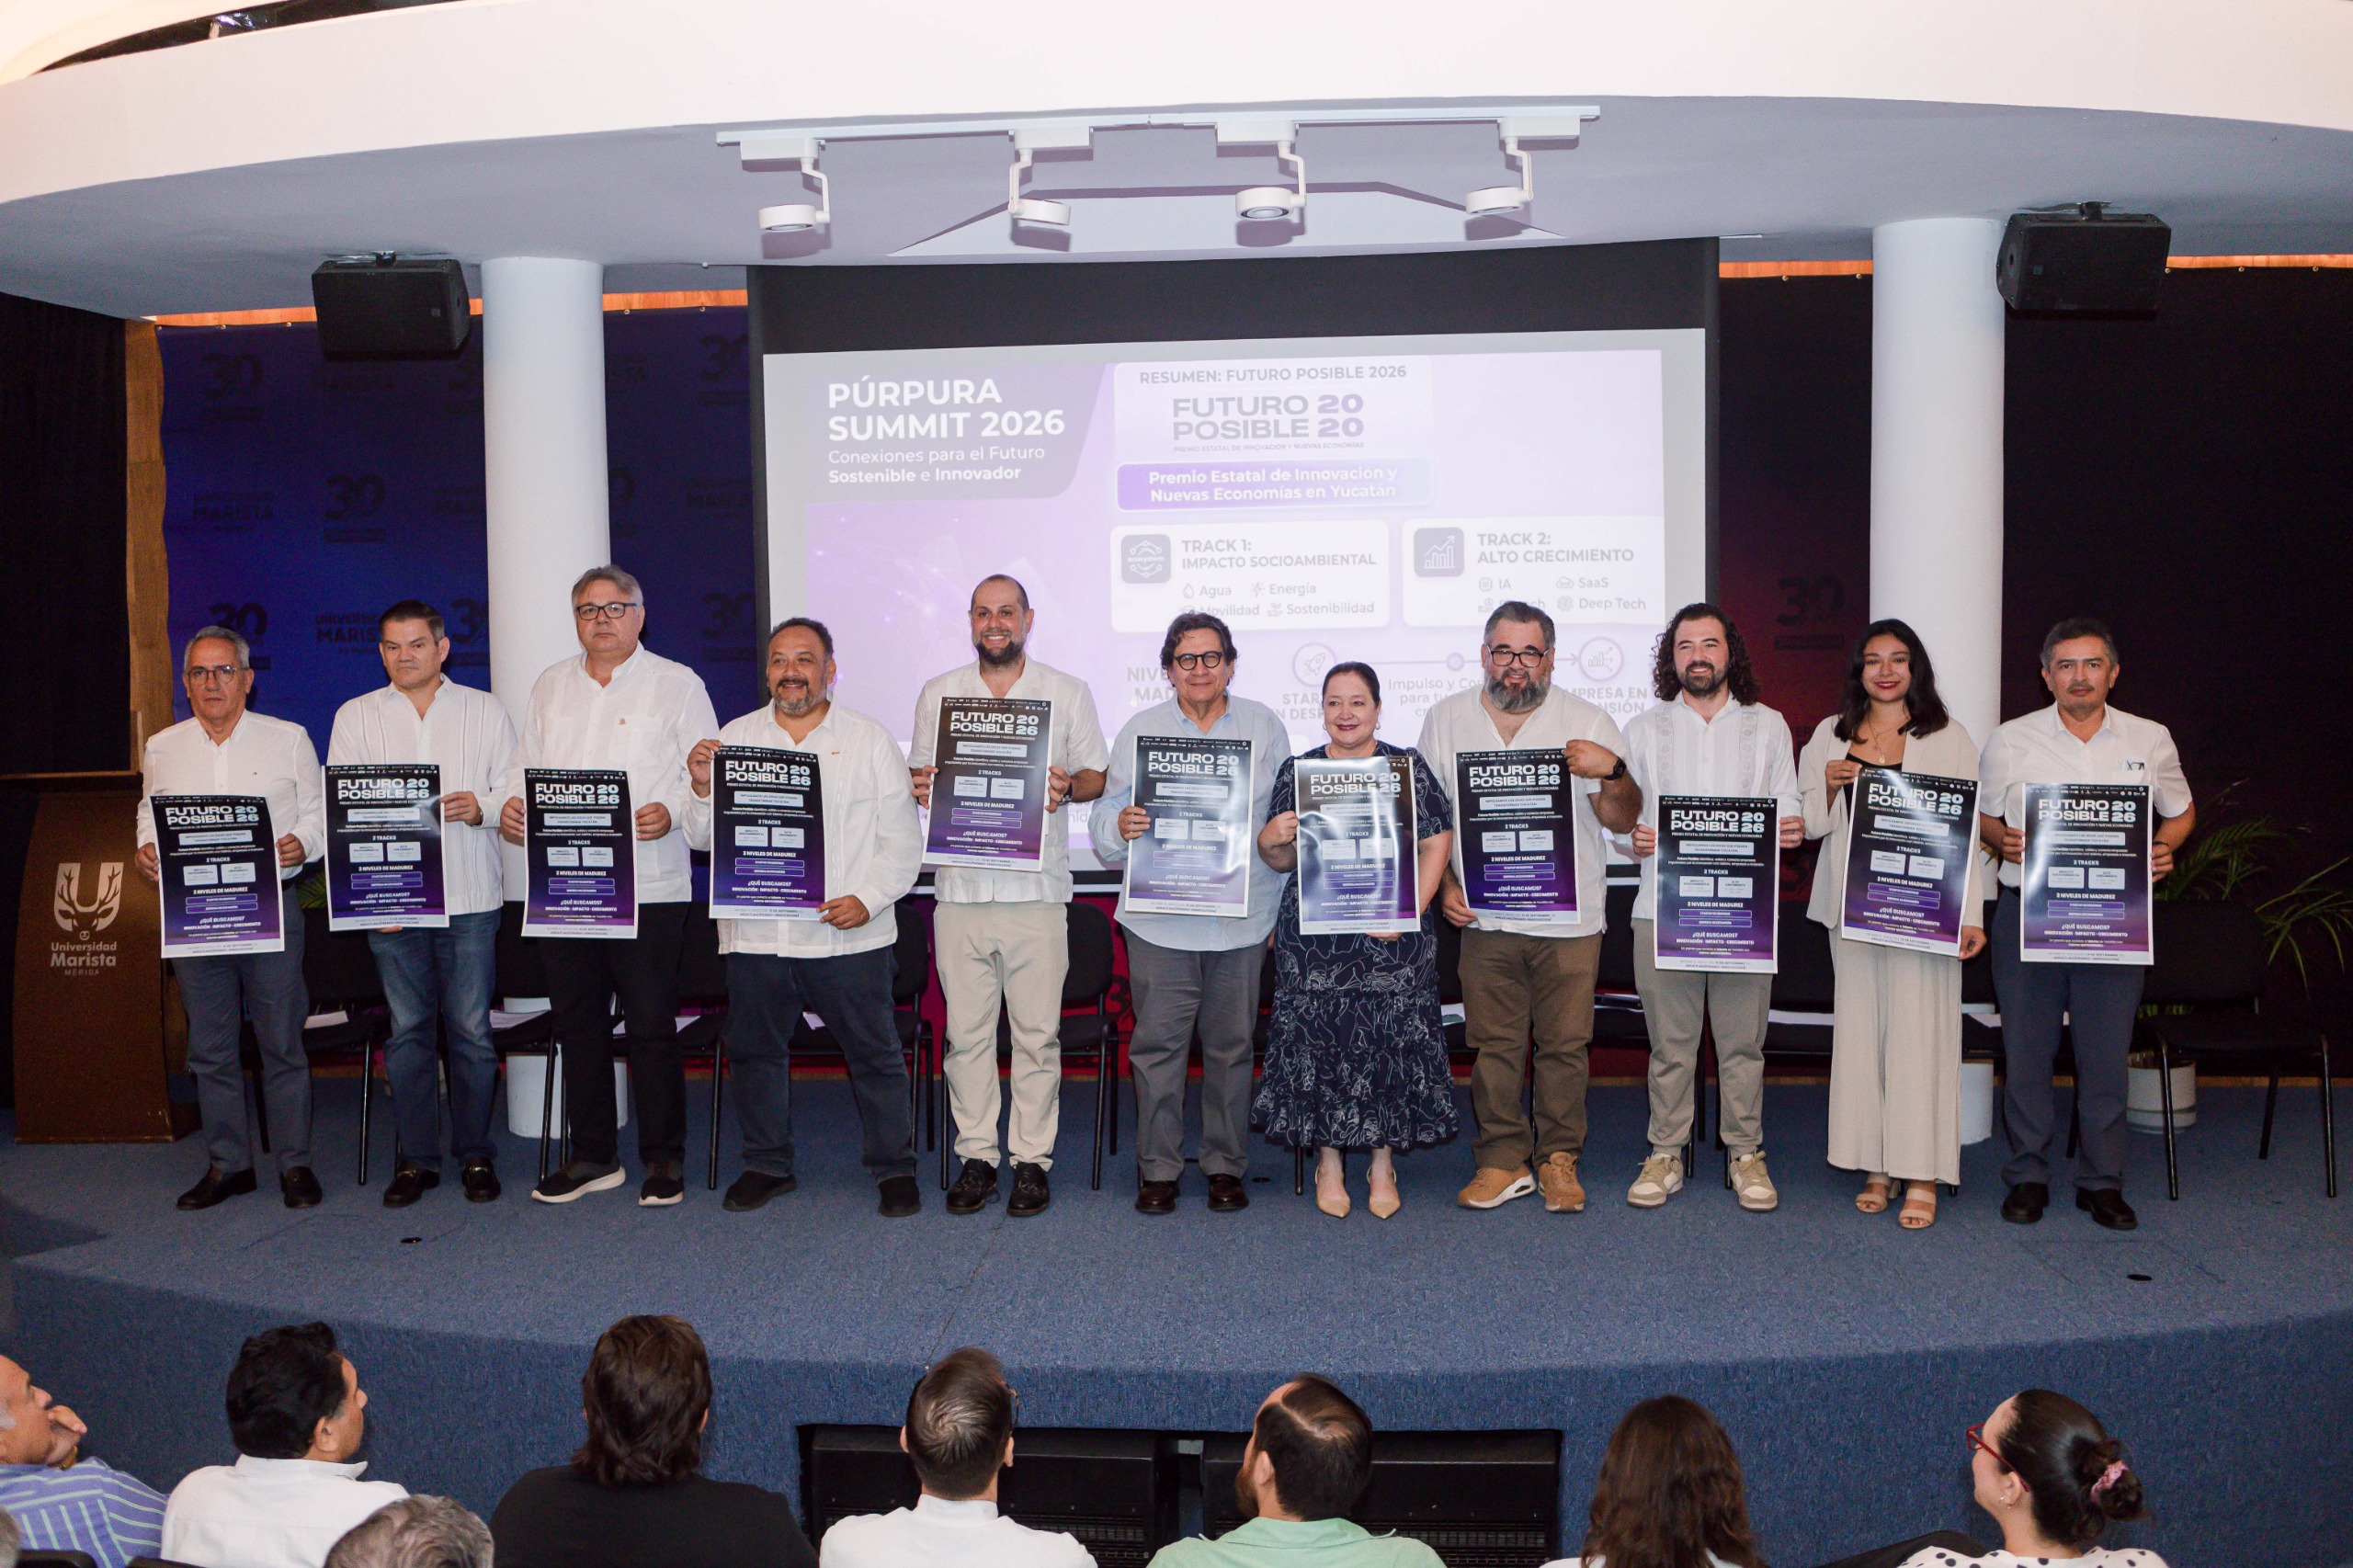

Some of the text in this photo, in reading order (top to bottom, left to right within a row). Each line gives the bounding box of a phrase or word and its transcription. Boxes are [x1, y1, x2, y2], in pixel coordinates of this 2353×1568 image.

[1140, 365, 1406, 384] RESUMEN: FUTURO POSIBLE 2026
[829, 375, 1003, 408] PÚRPURA
[1173, 393, 1364, 417] FUTURO 20
[829, 410, 1065, 441] SUMMIT 2026
[1173, 417, 1364, 440] POSIBLE 20
[1323, 441, 1364, 449] ECONOMÍAS
[829, 446, 1045, 465] Conexiones para el Futuro
[829, 466, 1021, 483] Sostenible e Innovador
[1149, 465, 1397, 484] Premio Estatal de Innovación y
[1151, 483, 1396, 503] Nuevas Economías en Yucatán
[1477, 532, 1552, 546] TRACK 2:
[1181, 539, 1252, 553] TRACK 1:
[1182, 553, 1377, 569] IMPACTO SOCIOAMBIENTAL
[1477, 549, 1633, 563] ALTO CRECIMIENTO
[1498, 577, 1609, 590] IA SaaS
[1199, 583, 1316, 599] Agua Energía
[1287, 602, 1374, 615] Sostenibilidad
[1579, 597, 1646, 613] Deep Tech
[1389, 677, 1443, 692] Impulso
[1448, 680, 1455, 690] y
[1400, 693, 1429, 706] para
[1563, 687, 1647, 700] MPRESA EN
[951, 712, 1039, 724] FUTURO 20
[950, 722, 1038, 735] POSIBLE 26
[1149, 752, 1239, 765] FUTURO 20
[726, 761, 810, 775] FUTURO 20
[1148, 762, 1238, 775] POSIBLE 26
[1470, 764, 1560, 776] FUTURO 20
[338, 779, 429, 789] FUTURO 20
[726, 772, 811, 785] POSIBLE 26
[1311, 772, 1400, 784] FUTURO 20
[1470, 775, 1560, 787] POSIBLE 26
[338, 789, 429, 799] POSIBLE 26
[536, 783, 618, 794] FUTURO 20
[1379, 783, 1401, 793] 26
[536, 794, 620, 804] POSIBLE 26
[1868, 794, 1962, 814] POSIBLE 26
[1940, 792, 1963, 803] 20
[166, 806, 232, 816] FUTURO
[2039, 799, 2136, 811] FUTURO 20
[167, 814, 259, 825] POSIBLE 26
[1671, 810, 1764, 822] FUTURO 20
[2039, 810, 2135, 822] POSIBLE 26
[1671, 821, 1764, 832] POSIBLE 26
[51, 941, 117, 951] Universidad
[51, 952, 117, 966] Marista
